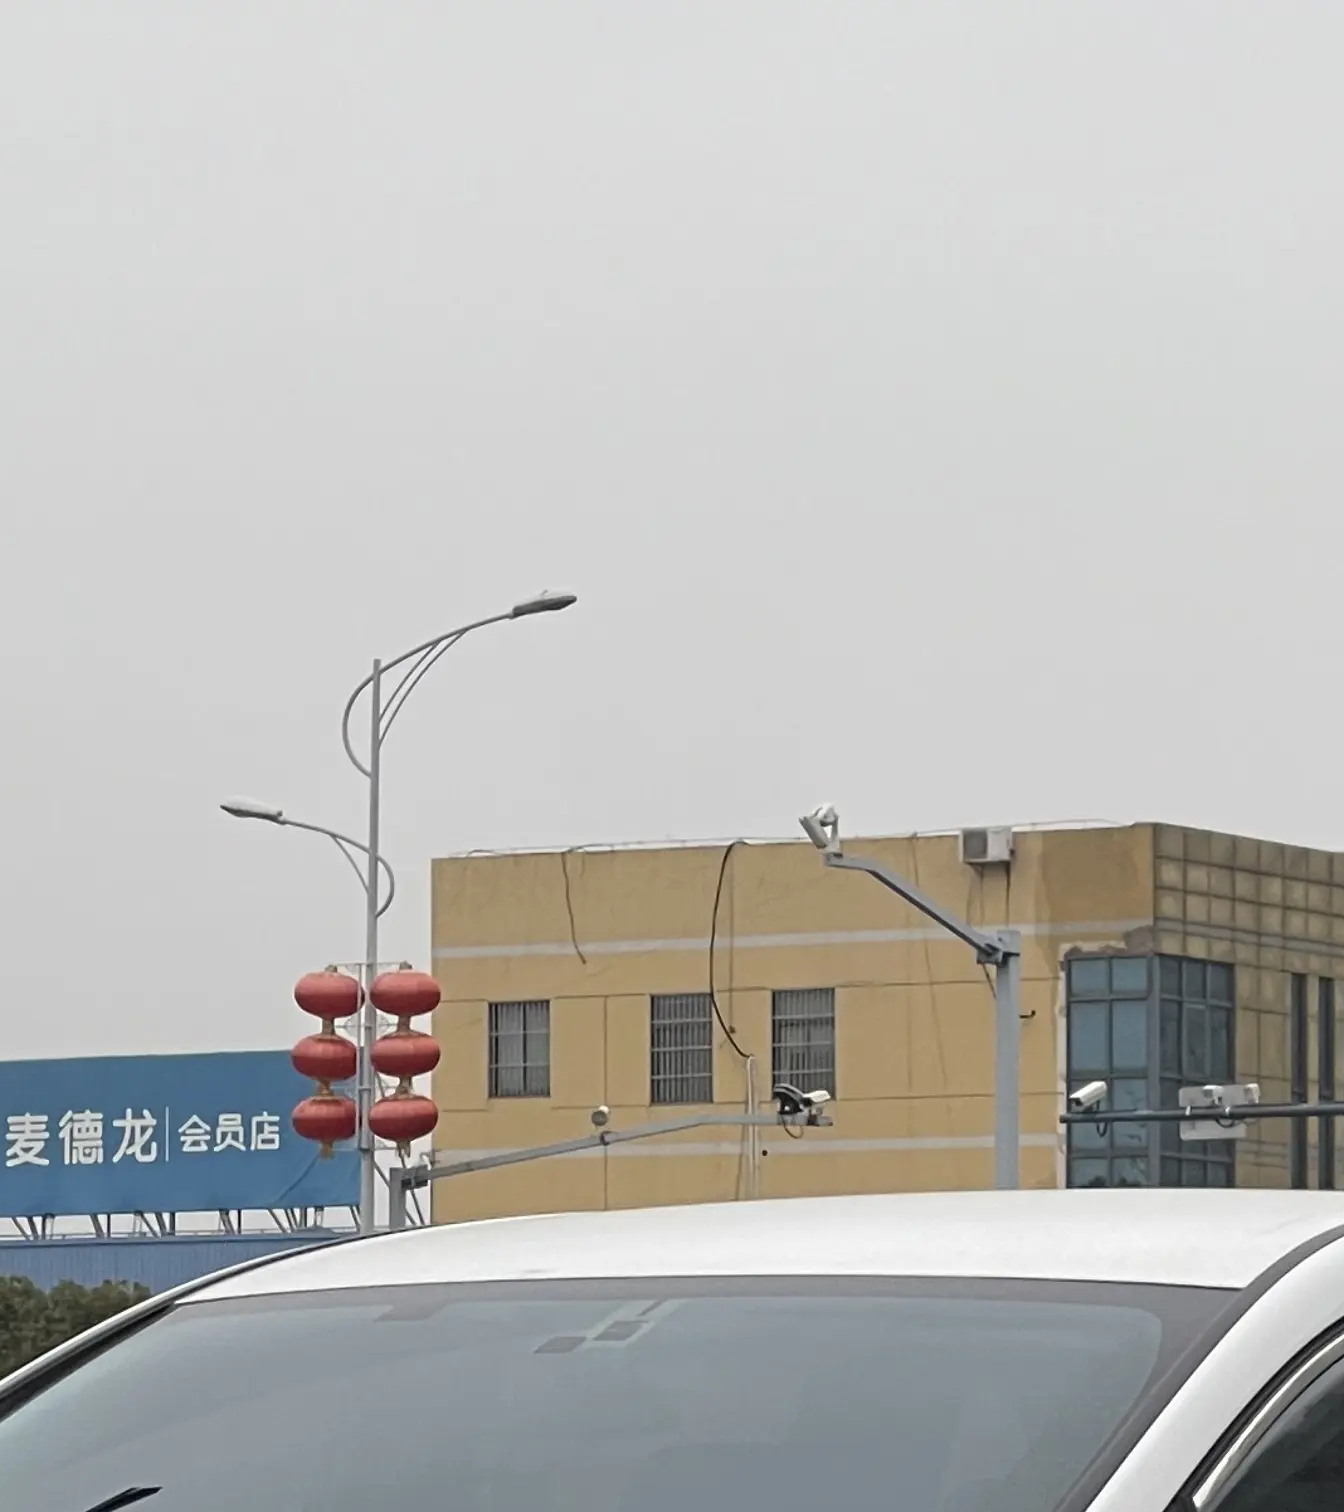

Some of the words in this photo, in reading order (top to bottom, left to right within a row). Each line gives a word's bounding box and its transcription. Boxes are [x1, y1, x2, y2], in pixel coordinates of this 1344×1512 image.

[6, 1108, 157, 1168] 麦德龙
[178, 1111, 281, 1153] 会员店
